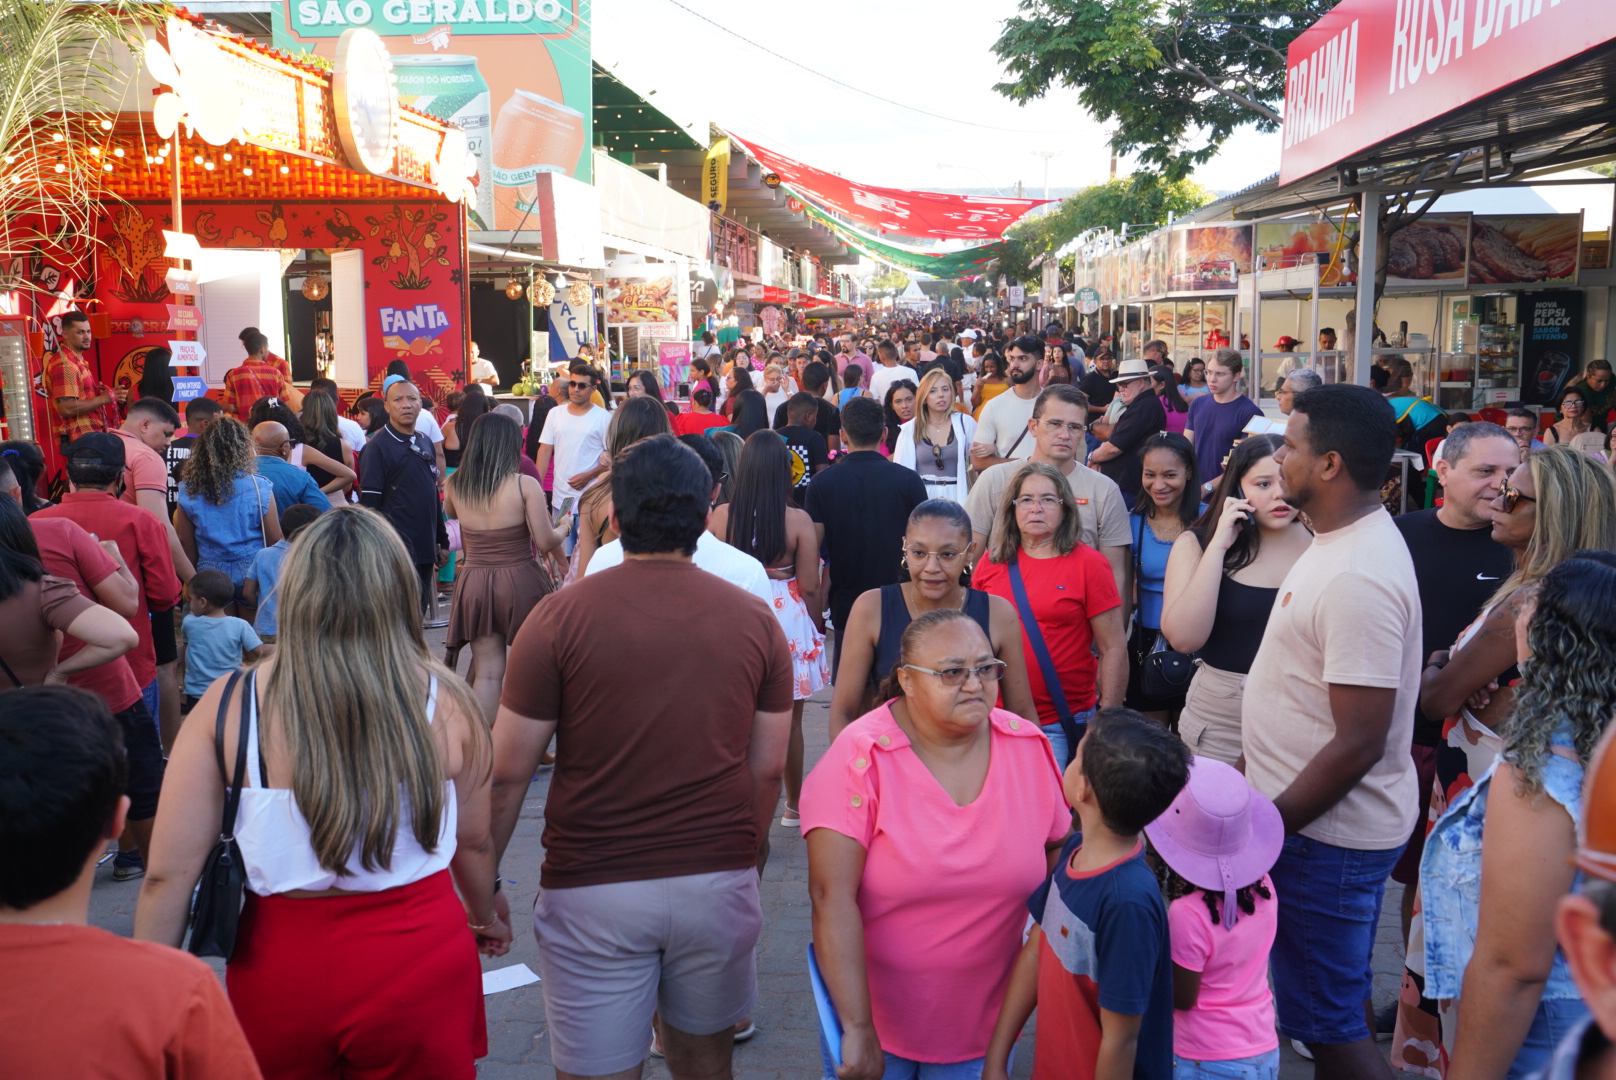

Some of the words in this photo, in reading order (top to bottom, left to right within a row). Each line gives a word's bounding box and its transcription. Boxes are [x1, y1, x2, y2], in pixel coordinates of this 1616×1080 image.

[383, 0, 564, 25] GERALDO
[399, 75, 425, 84] SABOR
[426, 75, 440, 83] DO
[440, 74, 475, 84] NORDESTE
[1284, 19, 1359, 150] BRAHMA
[622, 295, 662, 309] Churros
[380, 304, 449, 333] FANTA
[1533, 308, 1566, 317] PEPSI
[1533, 317, 1571, 326] BLACK
[179, 345, 191, 353] PRAÇA
[166, 446, 172, 459] É
[173, 447, 192, 459] TUD
